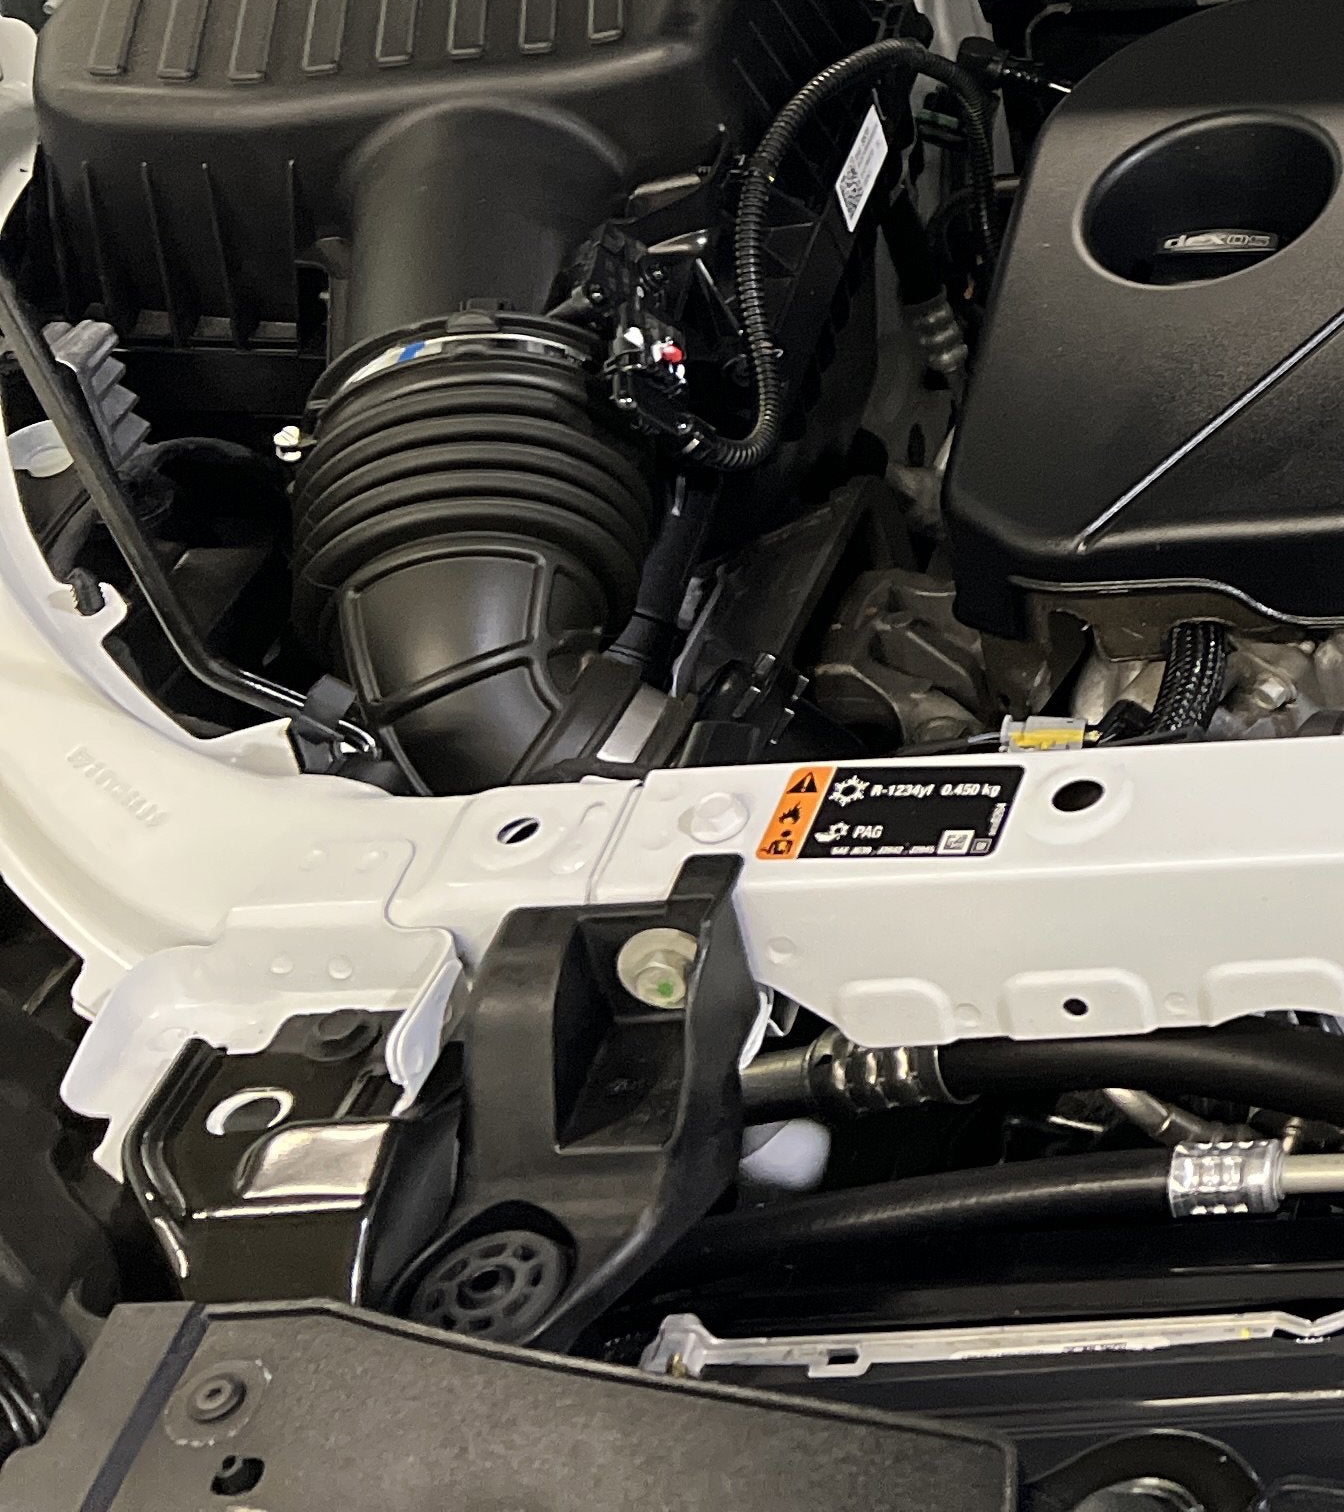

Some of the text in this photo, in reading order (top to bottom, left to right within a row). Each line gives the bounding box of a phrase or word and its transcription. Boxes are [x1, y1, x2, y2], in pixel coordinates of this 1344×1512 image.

[870, 783, 1001, 798] R-1234yf 0.450 kg
[852, 825, 884, 839] PAG
